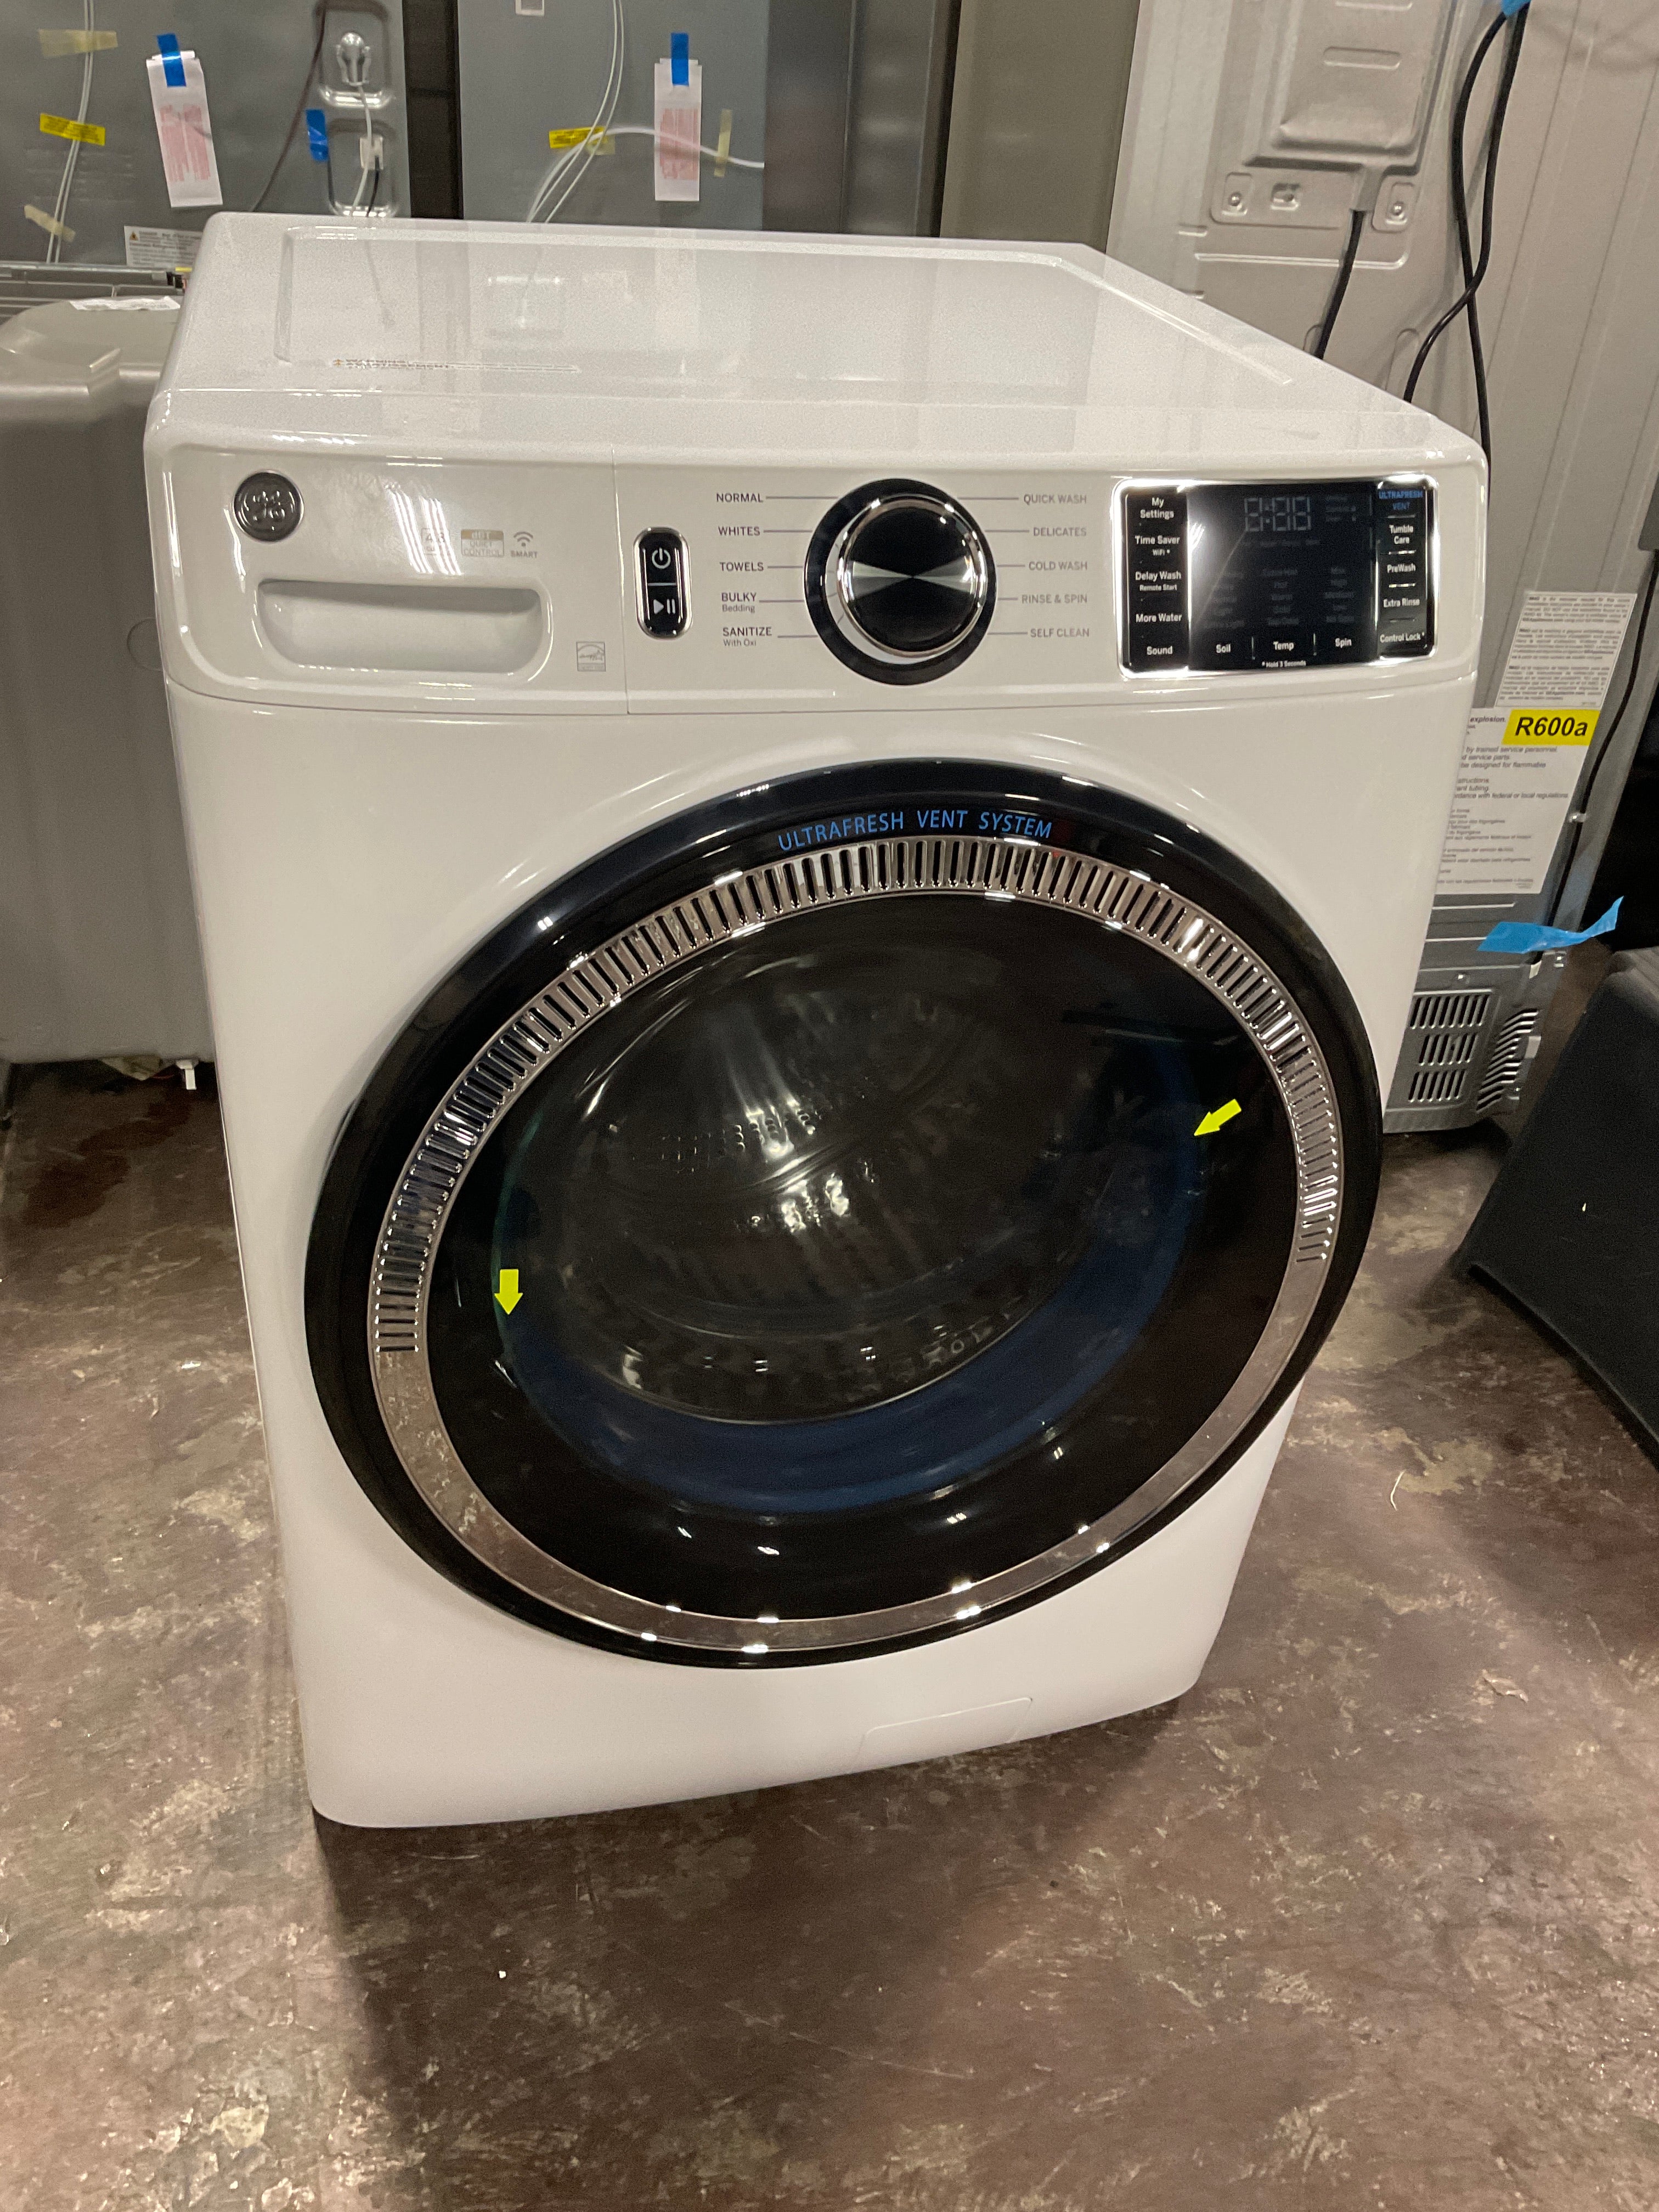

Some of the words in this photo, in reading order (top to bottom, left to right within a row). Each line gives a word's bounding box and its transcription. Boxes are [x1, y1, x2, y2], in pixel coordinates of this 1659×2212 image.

[716, 493, 764, 503] NORMAL
[1023, 494, 1056, 505] QUICK
[1057, 494, 1087, 504] WASH
[1379, 490, 1423, 499] ULTRAFRESH
[1152, 497, 1164, 508] My
[1140, 509, 1175, 520] Settings
[718, 526, 760, 536] WHITES
[1033, 527, 1087, 537] DELICATES
[1389, 524, 1414, 534] Tumble
[1135, 535, 1155, 545] Time
[1157, 535, 1180, 545] Saver
[1393, 535, 1410, 545] Care
[463, 549, 500, 557] CONTROL
[511, 550, 538, 558] SMART
[719, 562, 764, 571] TOWELS
[1029, 561, 1056, 571] COLD
[1058, 561, 1088, 571] WASH
[1387, 563, 1416, 573] PreWash
[1135, 571, 1158, 582] Delay
[1159, 571, 1181, 580] Wash
[721, 592, 757, 602] BULKY
[1022, 594, 1051, 603] RINSE
[1054, 594, 1061, 603] &
[1064, 594, 1088, 603] SPIN
[1383, 598, 1401, 608] Extra
[1402, 597, 1420, 606] Rinse
[722, 604, 755, 613] Bedding
[1135, 613, 1157, 623] More
[1158, 613, 1182, 622] Water
[723, 627, 772, 636] SANITIZE
[1030, 628, 1054, 637] SELF
[1056, 628, 1090, 637] CLEAN
[723, 638, 741, 647] With
[743, 638, 757, 647] Oxi
[1335, 637, 1352, 648] Spin
[1380, 633, 1404, 643] Control
[1146, 646, 1173, 656] Sound
[1216, 644, 1231, 653] Soil
[1273, 641, 1295, 651] Temp
[1515, 716, 1588, 737] R600a
[777, 811, 904, 851] ULTRAFRESH
[917, 809, 968, 829] VENT
[978, 811, 1052, 839] SYSTEM
